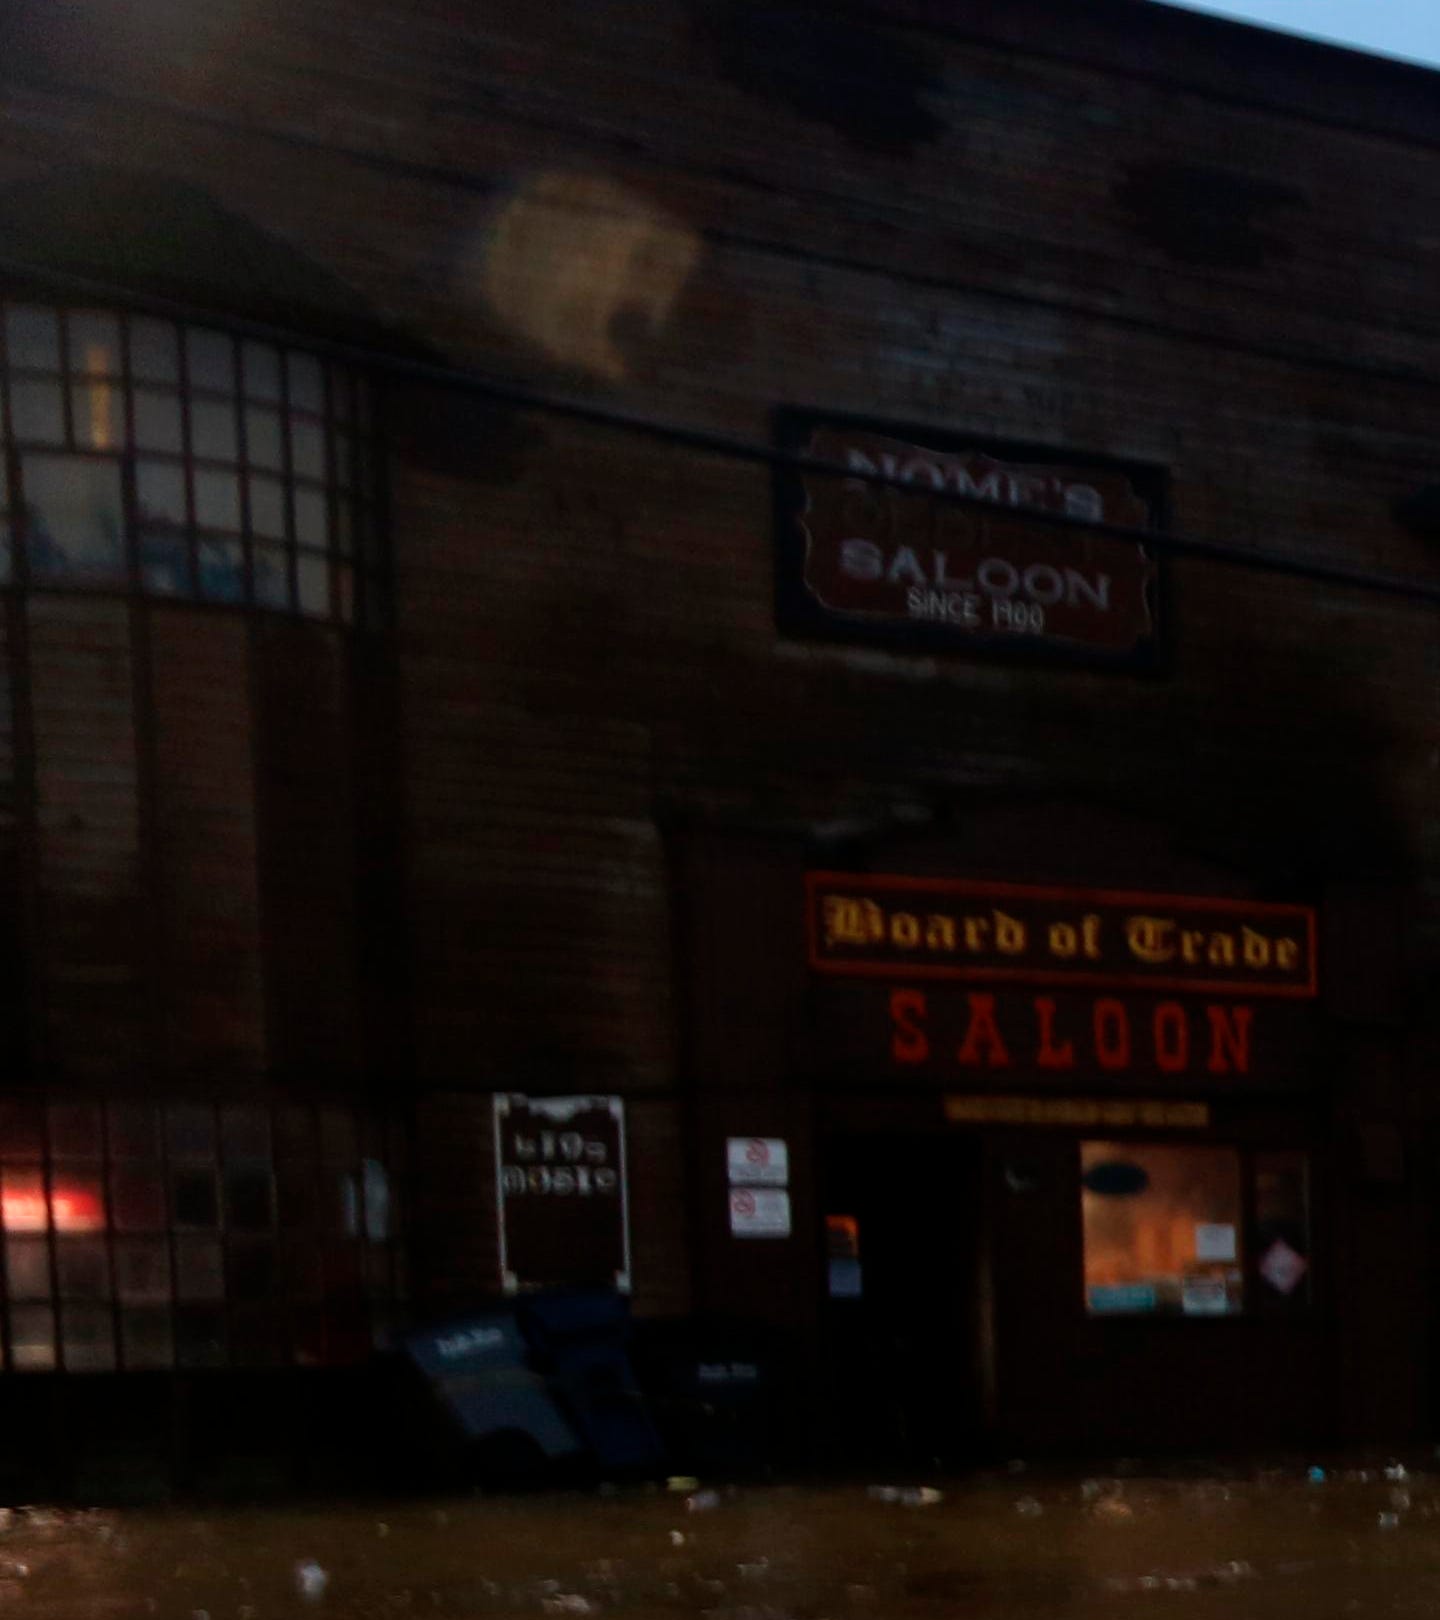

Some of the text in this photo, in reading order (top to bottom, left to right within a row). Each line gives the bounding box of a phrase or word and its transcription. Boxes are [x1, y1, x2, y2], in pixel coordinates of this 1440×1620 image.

[839, 537, 1111, 612] SALOON
[907, 585, 981, 627] SINCE
[822, 893, 1300, 972] Board of Trade
[888, 987, 1256, 1075] SALOON
